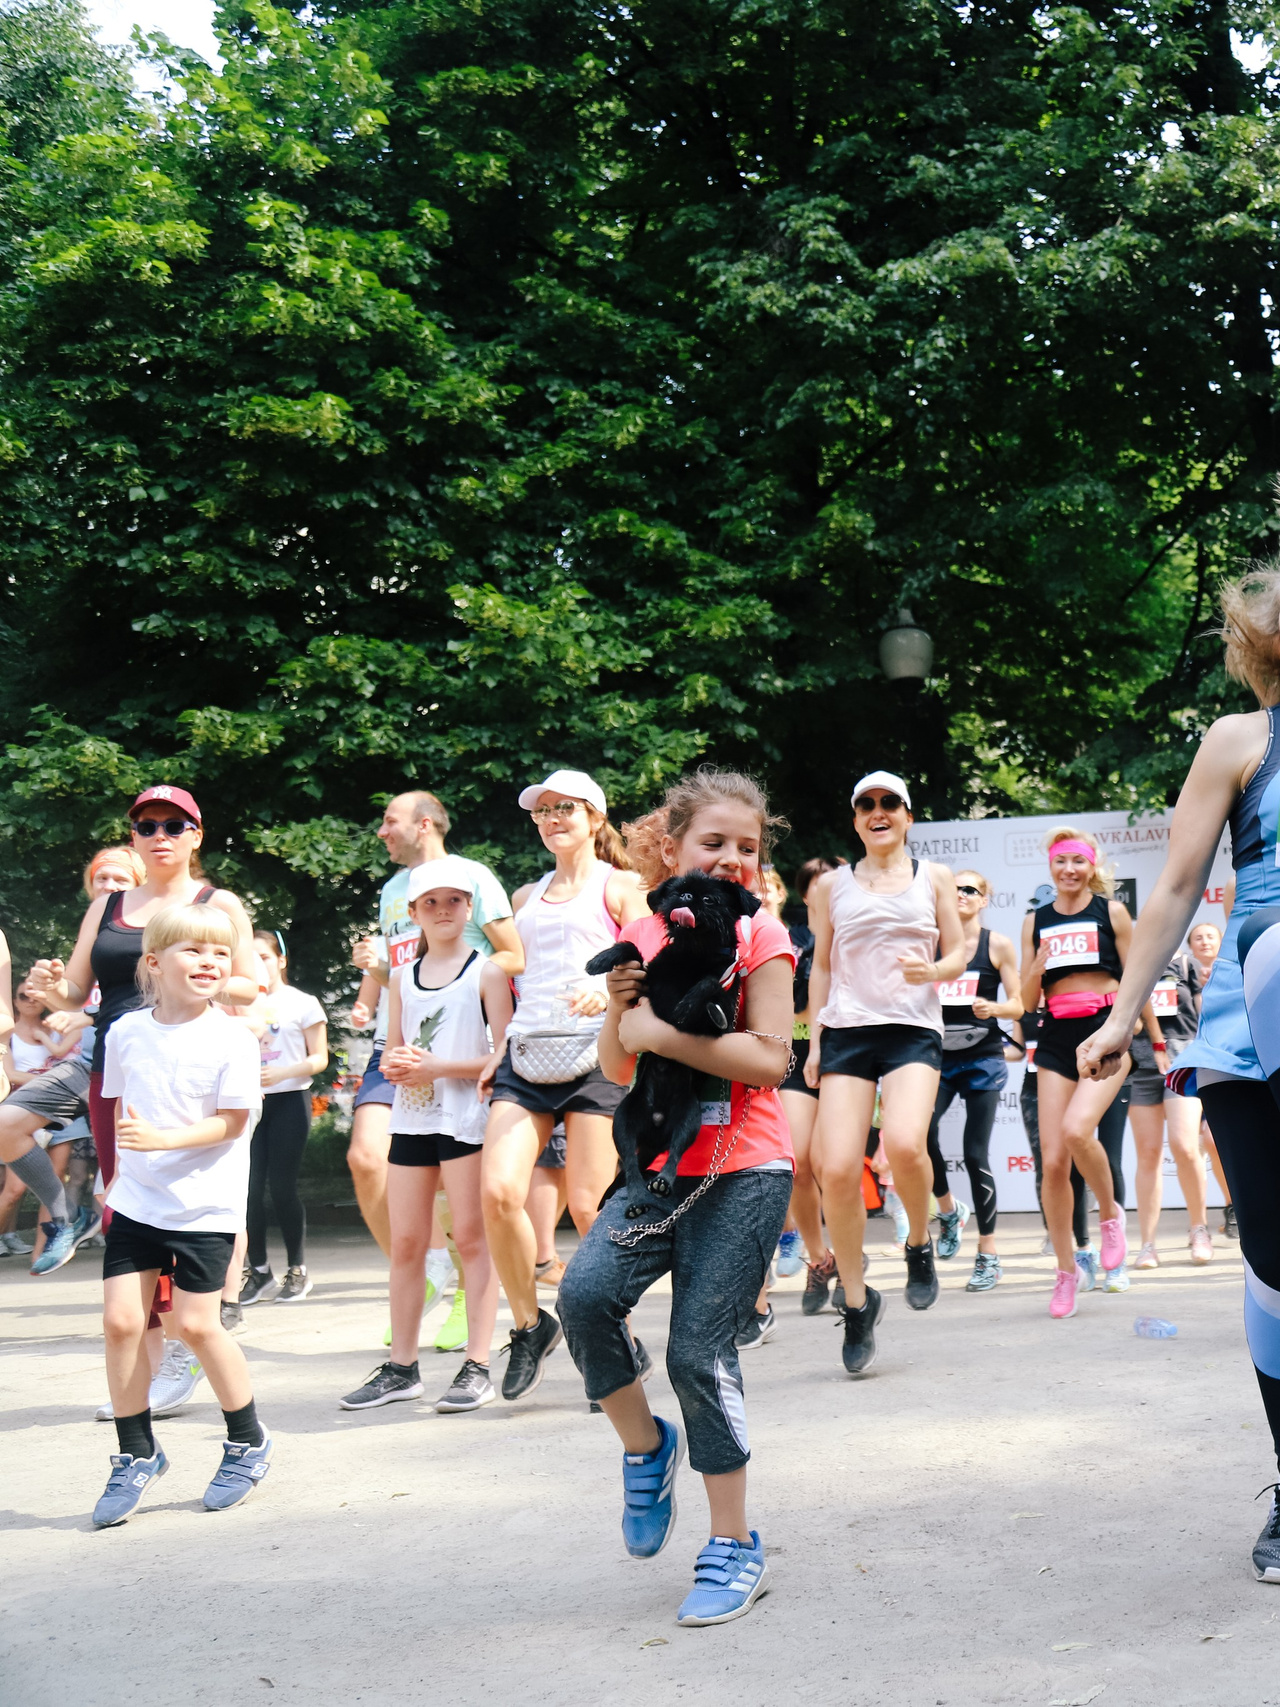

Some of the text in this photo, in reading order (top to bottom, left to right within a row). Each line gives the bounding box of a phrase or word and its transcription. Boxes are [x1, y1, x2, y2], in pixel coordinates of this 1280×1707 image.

[911, 837, 980, 856] PATRIKI
[1050, 934, 1088, 956] 046
[938, 981, 968, 998] 041
